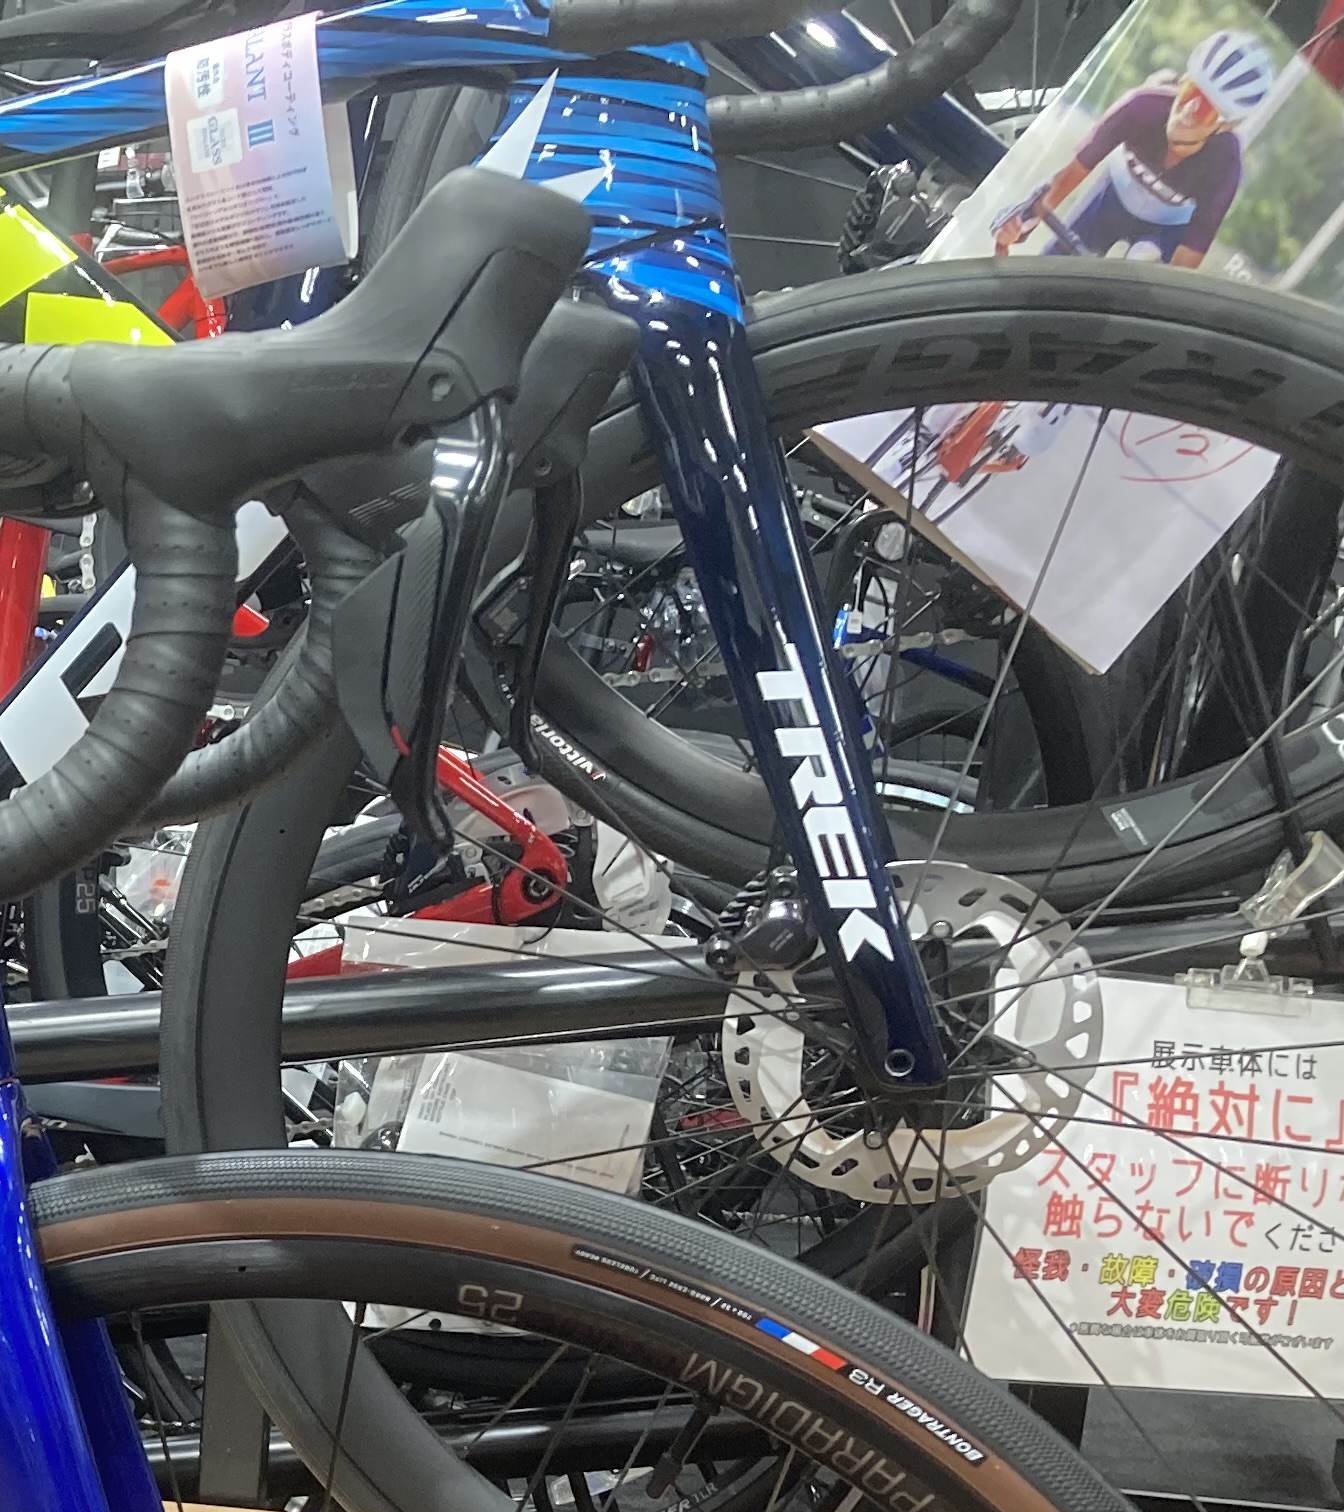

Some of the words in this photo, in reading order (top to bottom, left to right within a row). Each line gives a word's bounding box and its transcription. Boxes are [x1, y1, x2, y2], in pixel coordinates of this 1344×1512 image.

[755, 642, 895, 962] TREK
[1150, 1039, 1318, 1082] 展示車体には
[849, 1368, 886, 1396] R3
[887, 1391, 985, 1462] BONTRAGER
